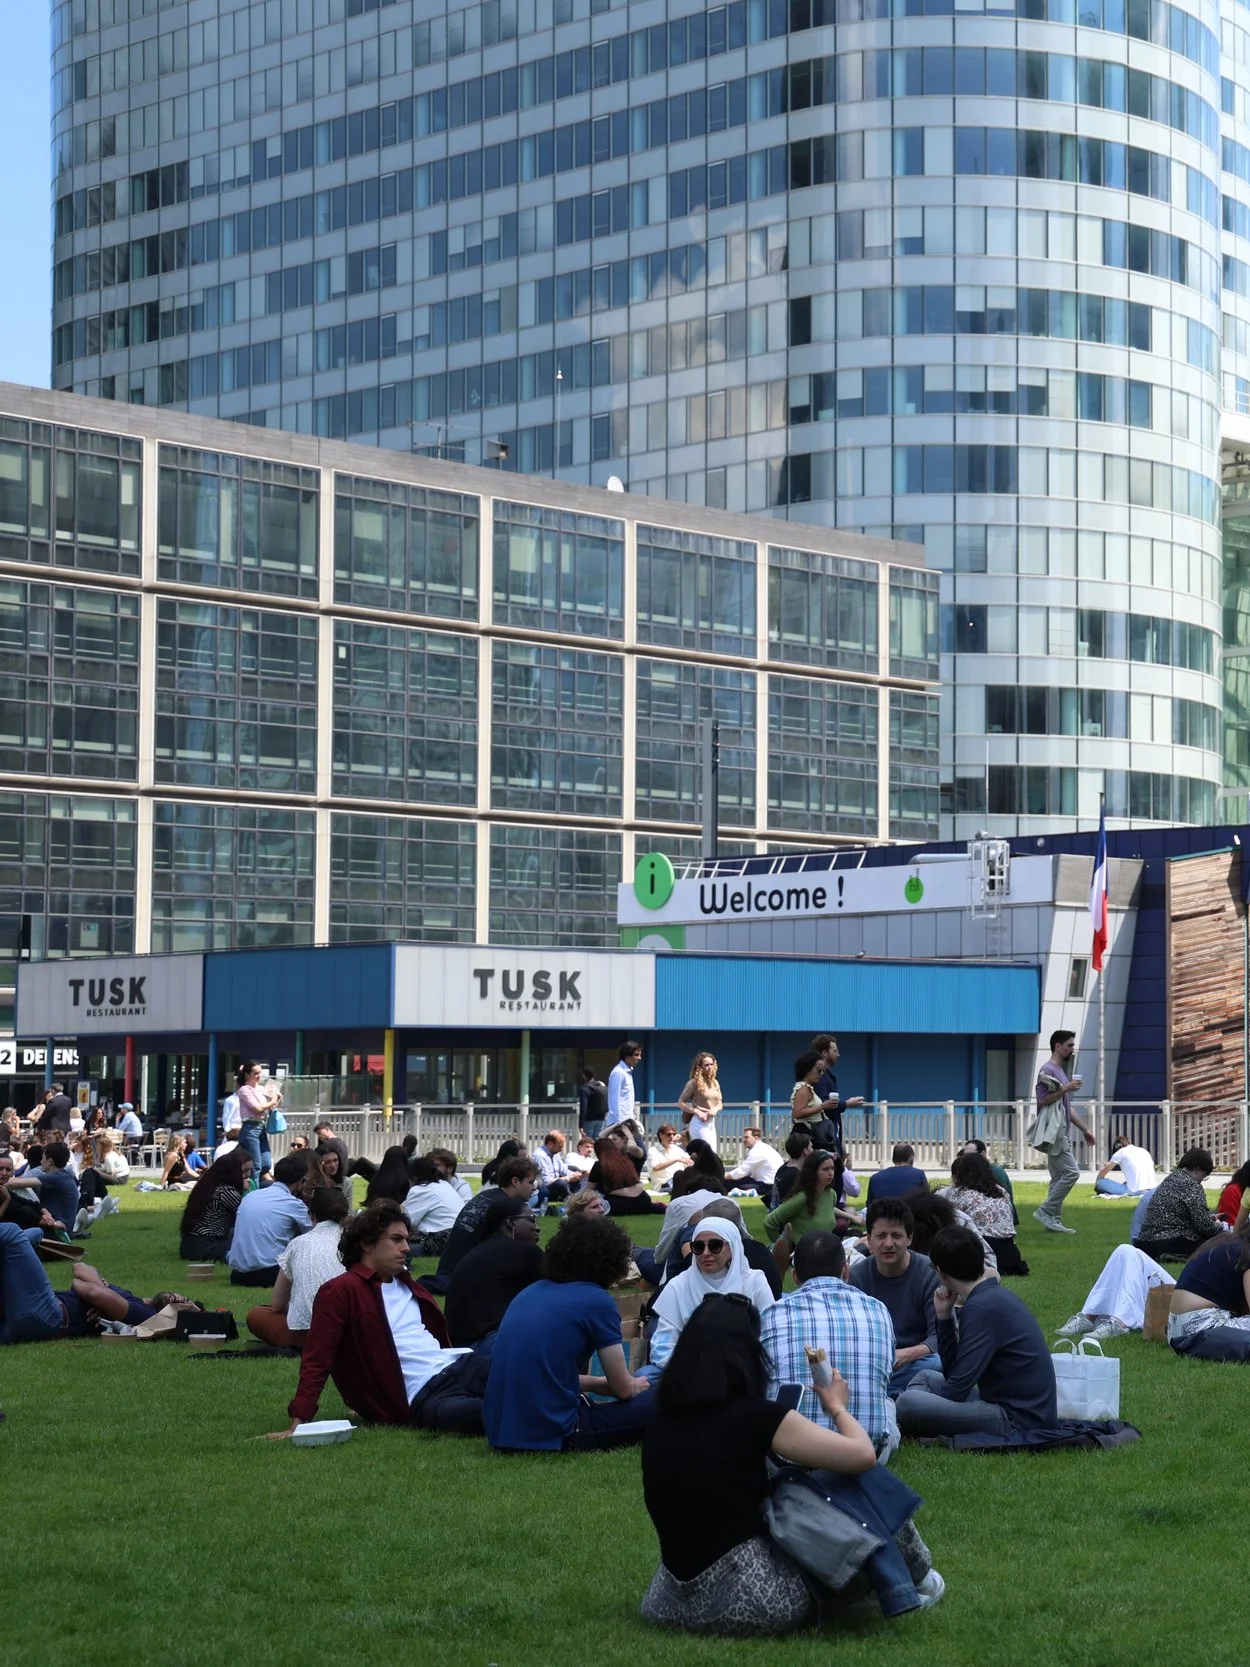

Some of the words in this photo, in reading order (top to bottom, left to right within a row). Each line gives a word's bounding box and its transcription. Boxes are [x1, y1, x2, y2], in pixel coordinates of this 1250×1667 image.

[699, 881, 827, 914] Welcome
[68, 976, 147, 1006] TUSK
[473, 968, 582, 1000] TUSK
[86, 1007, 147, 1017] RESTAURANT
[499, 1001, 582, 1011] RESTAURANT
